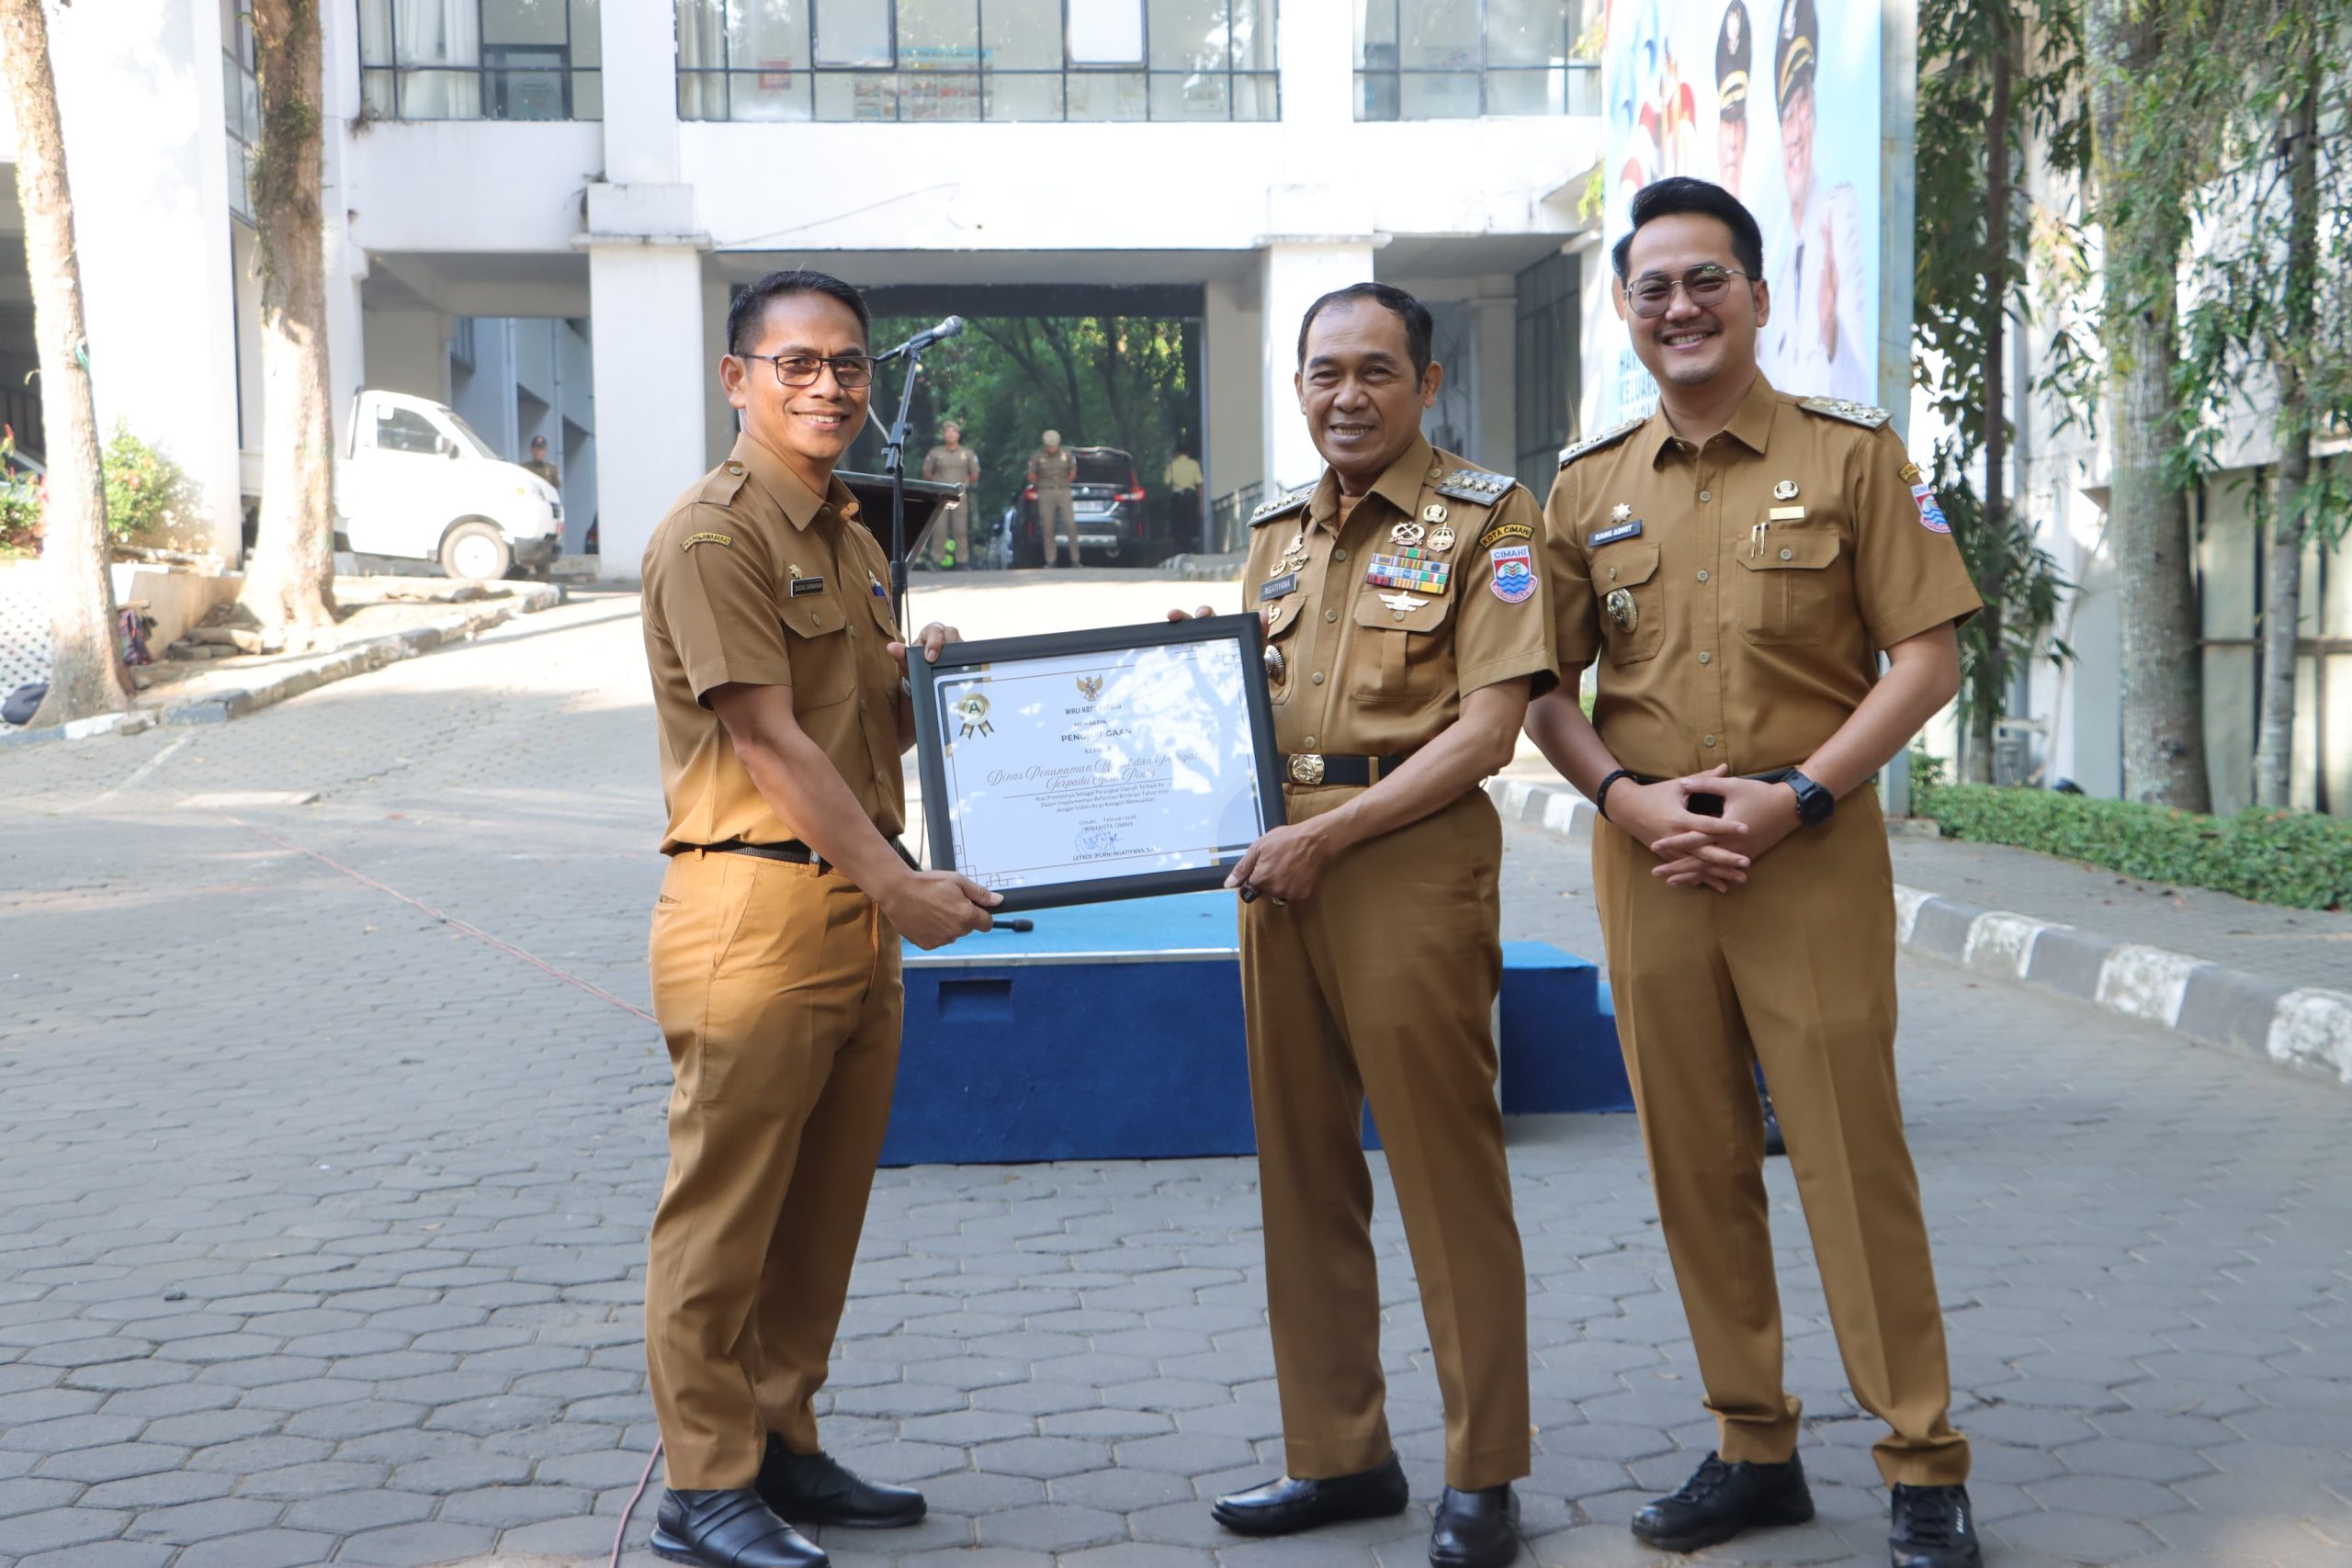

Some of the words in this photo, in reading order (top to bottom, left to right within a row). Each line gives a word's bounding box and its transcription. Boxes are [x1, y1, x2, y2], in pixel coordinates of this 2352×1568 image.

[1619, 372, 1659, 406] KELUARG
[1482, 530, 1503, 547] KOTA
[1504, 526, 1531, 536] CIMAHI
[1494, 549, 1528, 559] CIMAHI
[968, 703, 980, 714] A
[1065, 707, 1081, 716] WALI
[987, 770, 1023, 786] Dinas
